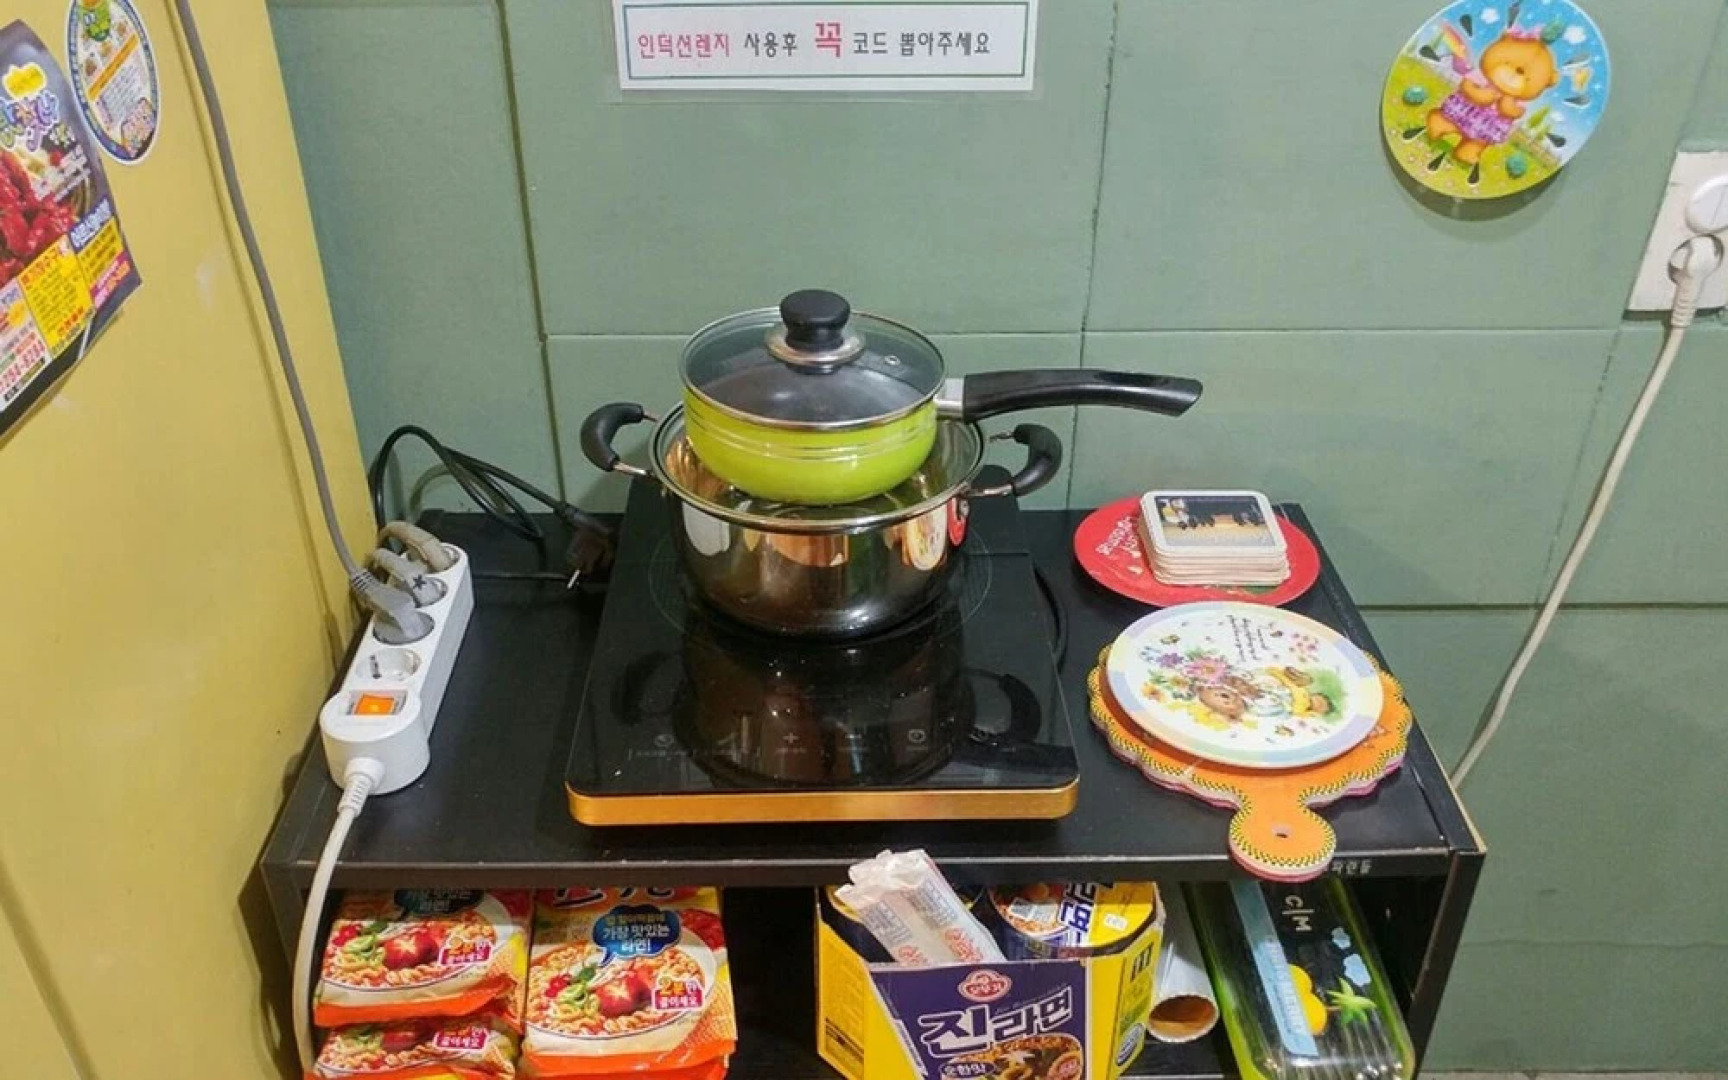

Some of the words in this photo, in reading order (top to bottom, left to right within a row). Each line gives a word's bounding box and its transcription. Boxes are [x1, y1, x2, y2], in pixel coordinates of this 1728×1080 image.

[637, 32, 731, 59] 인덕션렌지
[743, 32, 798, 58] 사용후
[814, 22, 843, 57] 꼭
[852, 31, 888, 55] 코드
[899, 31, 991, 57] 뽑아주세요
[917, 986, 1072, 1058] 진라면
